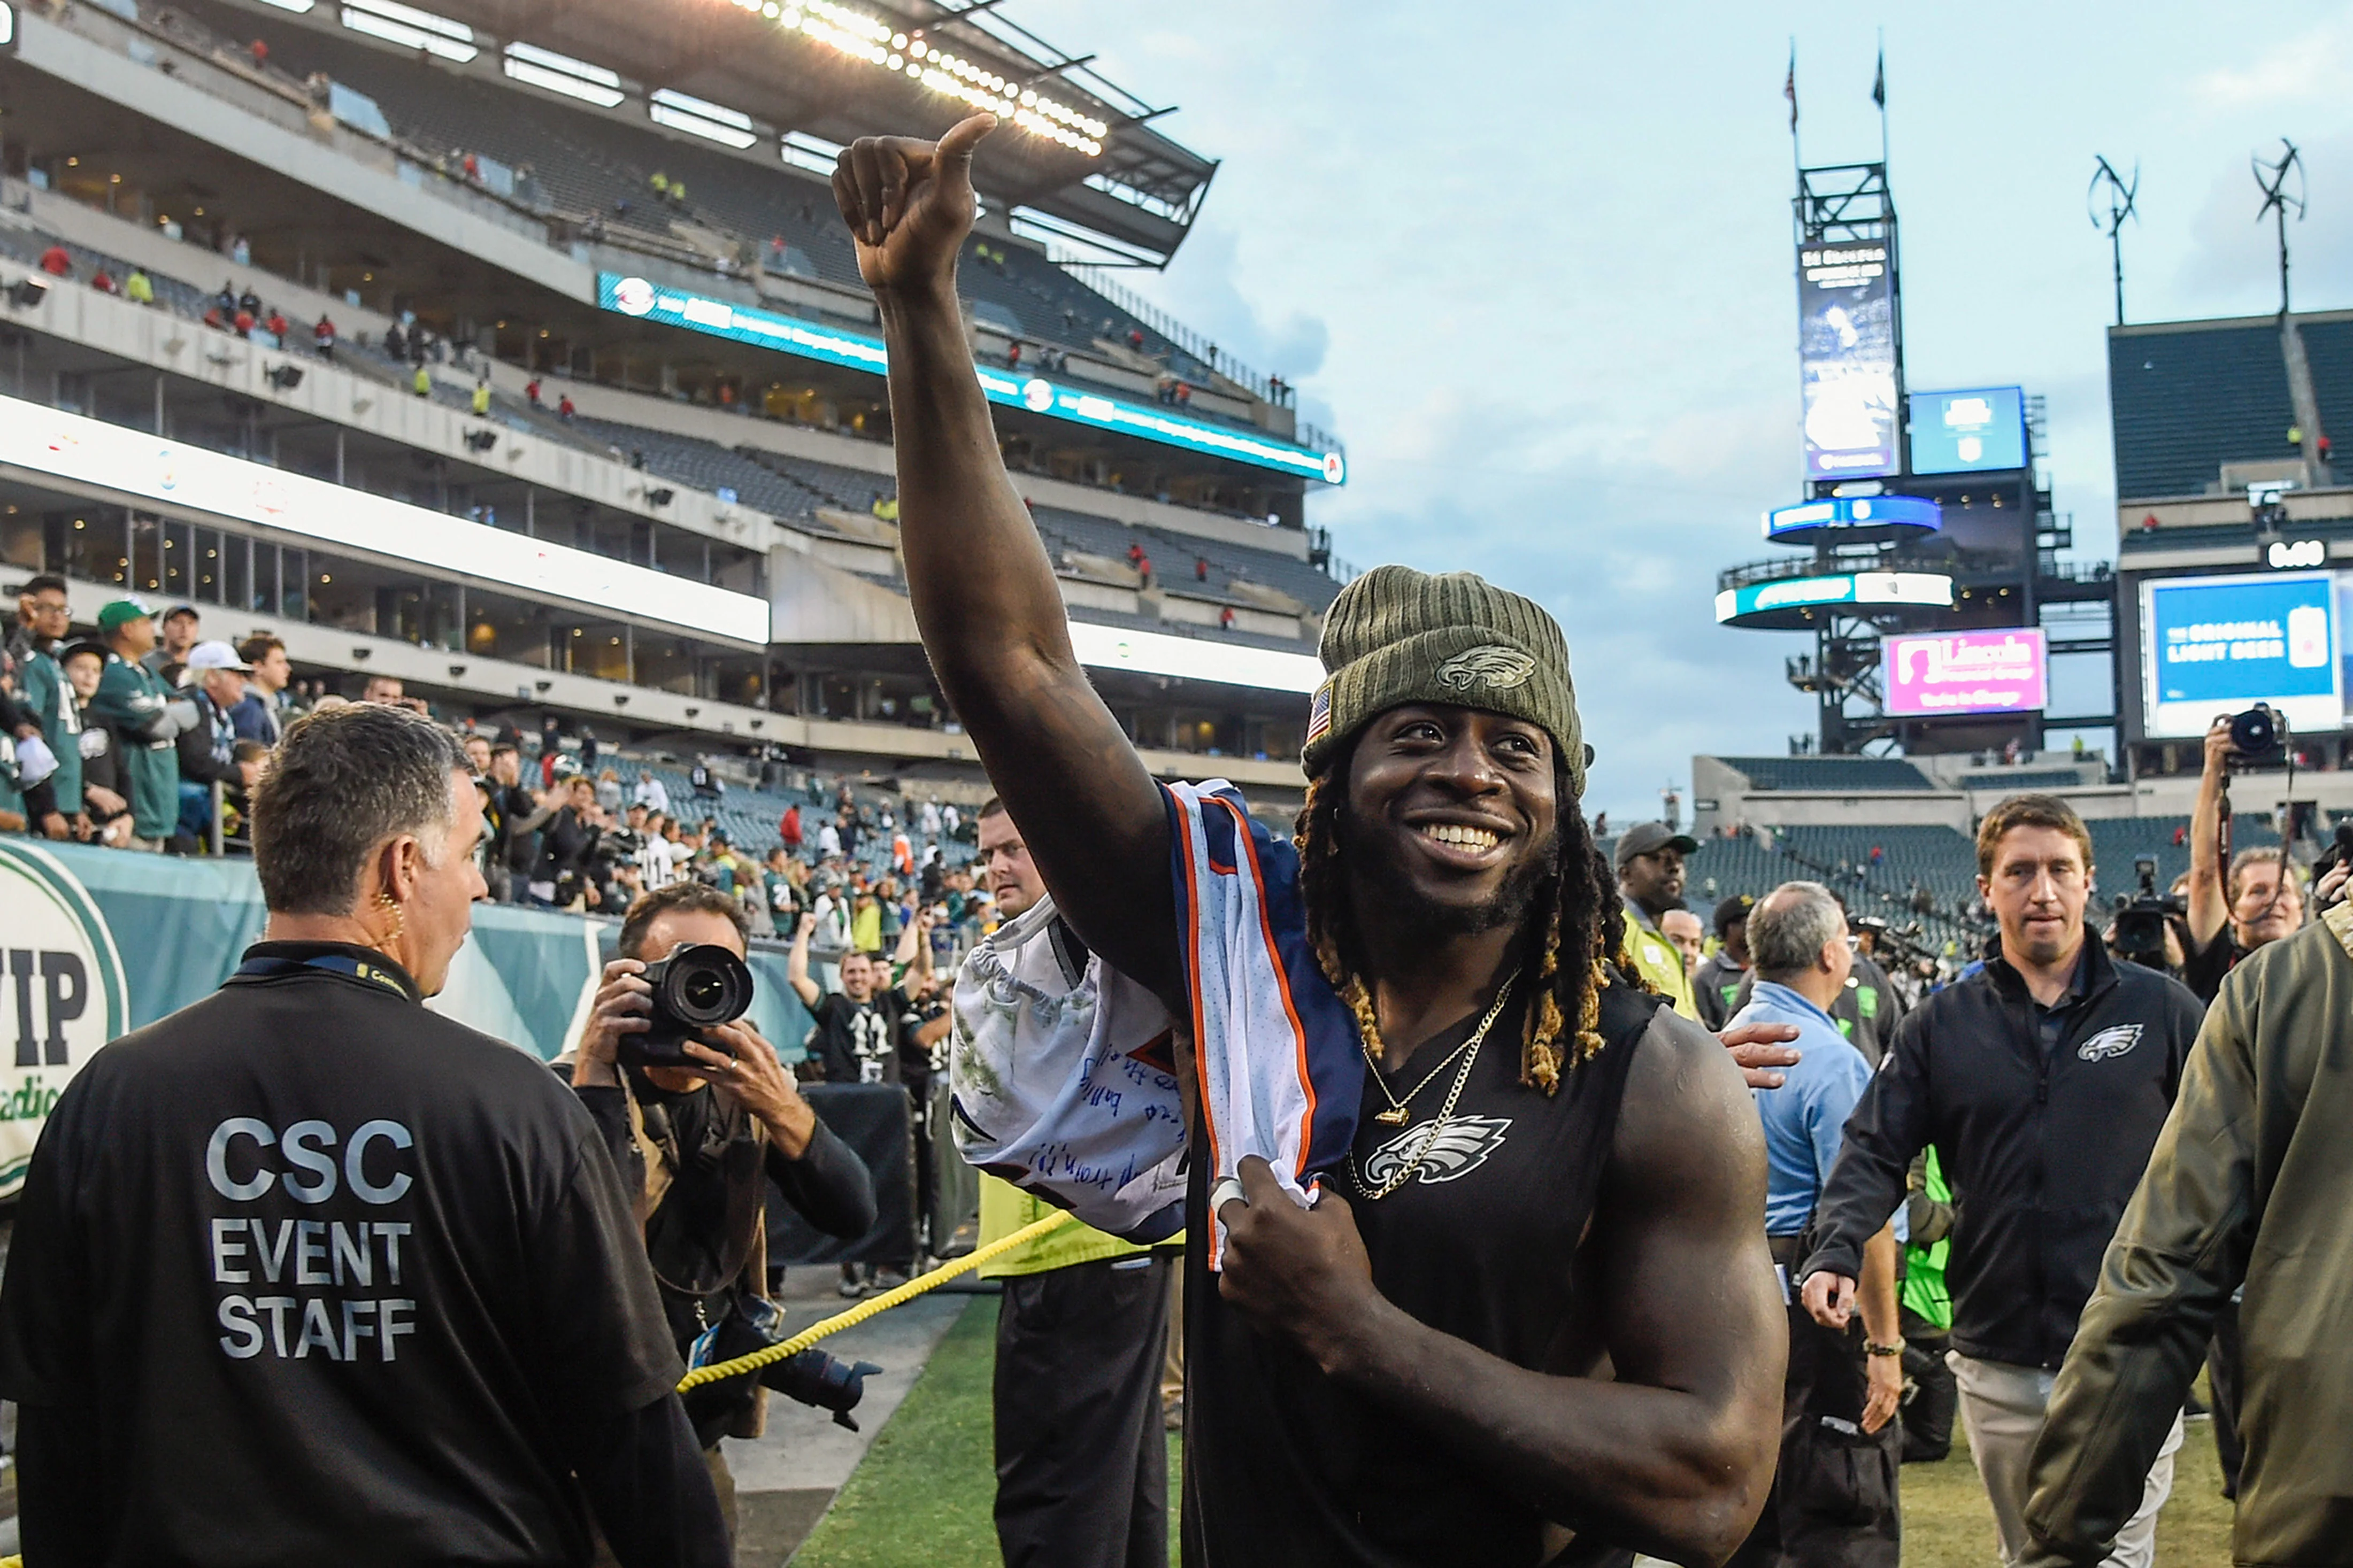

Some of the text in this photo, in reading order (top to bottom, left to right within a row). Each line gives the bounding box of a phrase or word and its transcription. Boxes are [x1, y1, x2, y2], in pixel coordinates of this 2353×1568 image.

[0, 948, 88, 1067] IP
[206, 1116, 413, 1204] CSC
[211, 1218, 412, 1287] EVENT
[217, 1294, 416, 1362] STAFF
